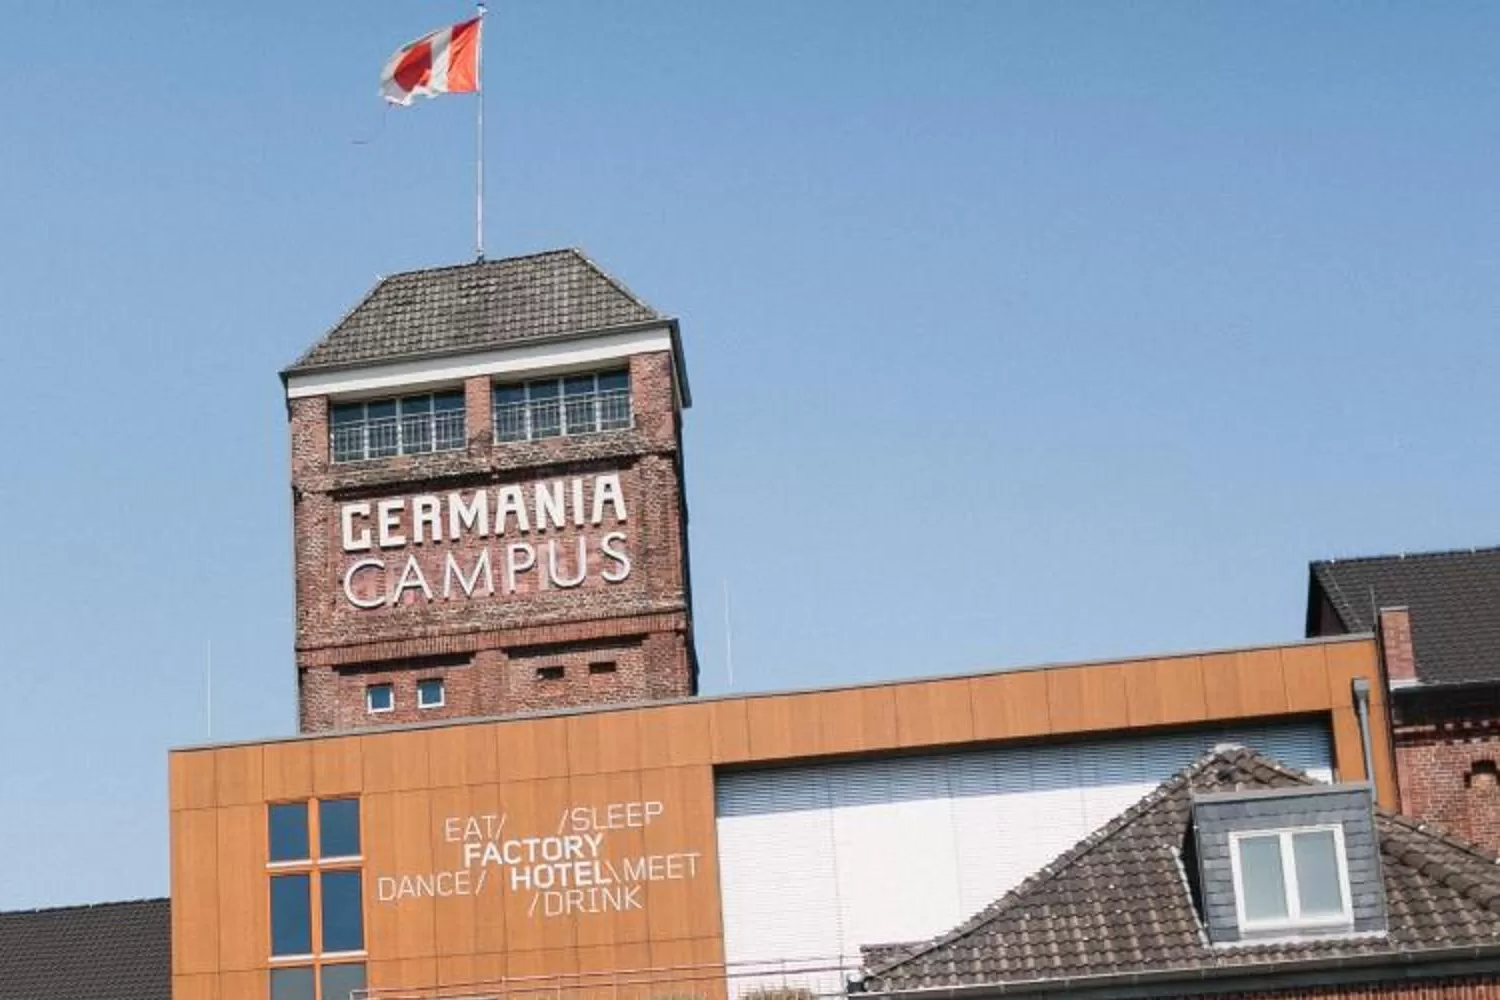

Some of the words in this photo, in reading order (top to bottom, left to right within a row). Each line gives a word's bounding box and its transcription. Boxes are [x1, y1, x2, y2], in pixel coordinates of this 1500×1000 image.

[341, 472, 627, 552] GERMANIA
[343, 532, 632, 609] CAMPUS
[464, 832, 604, 868] FACTORY
[511, 861, 612, 891] HOTEL
